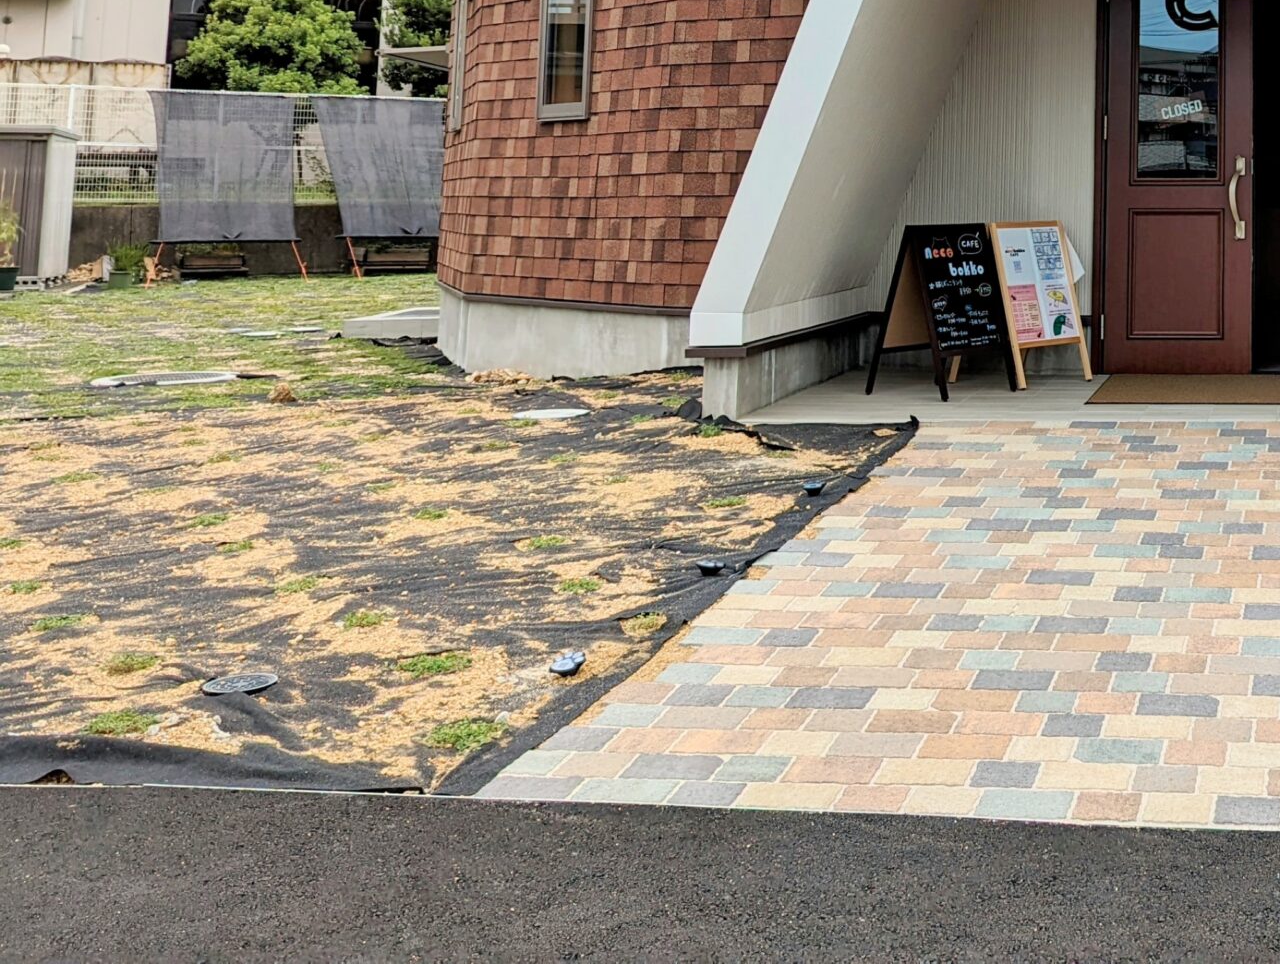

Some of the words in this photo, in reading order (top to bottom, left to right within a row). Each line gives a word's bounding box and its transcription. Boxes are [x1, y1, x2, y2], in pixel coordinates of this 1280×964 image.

[1161, 99, 1203, 120] CLOSED
[961, 240, 980, 249] CAFE
[948, 261, 985, 276] bokko
